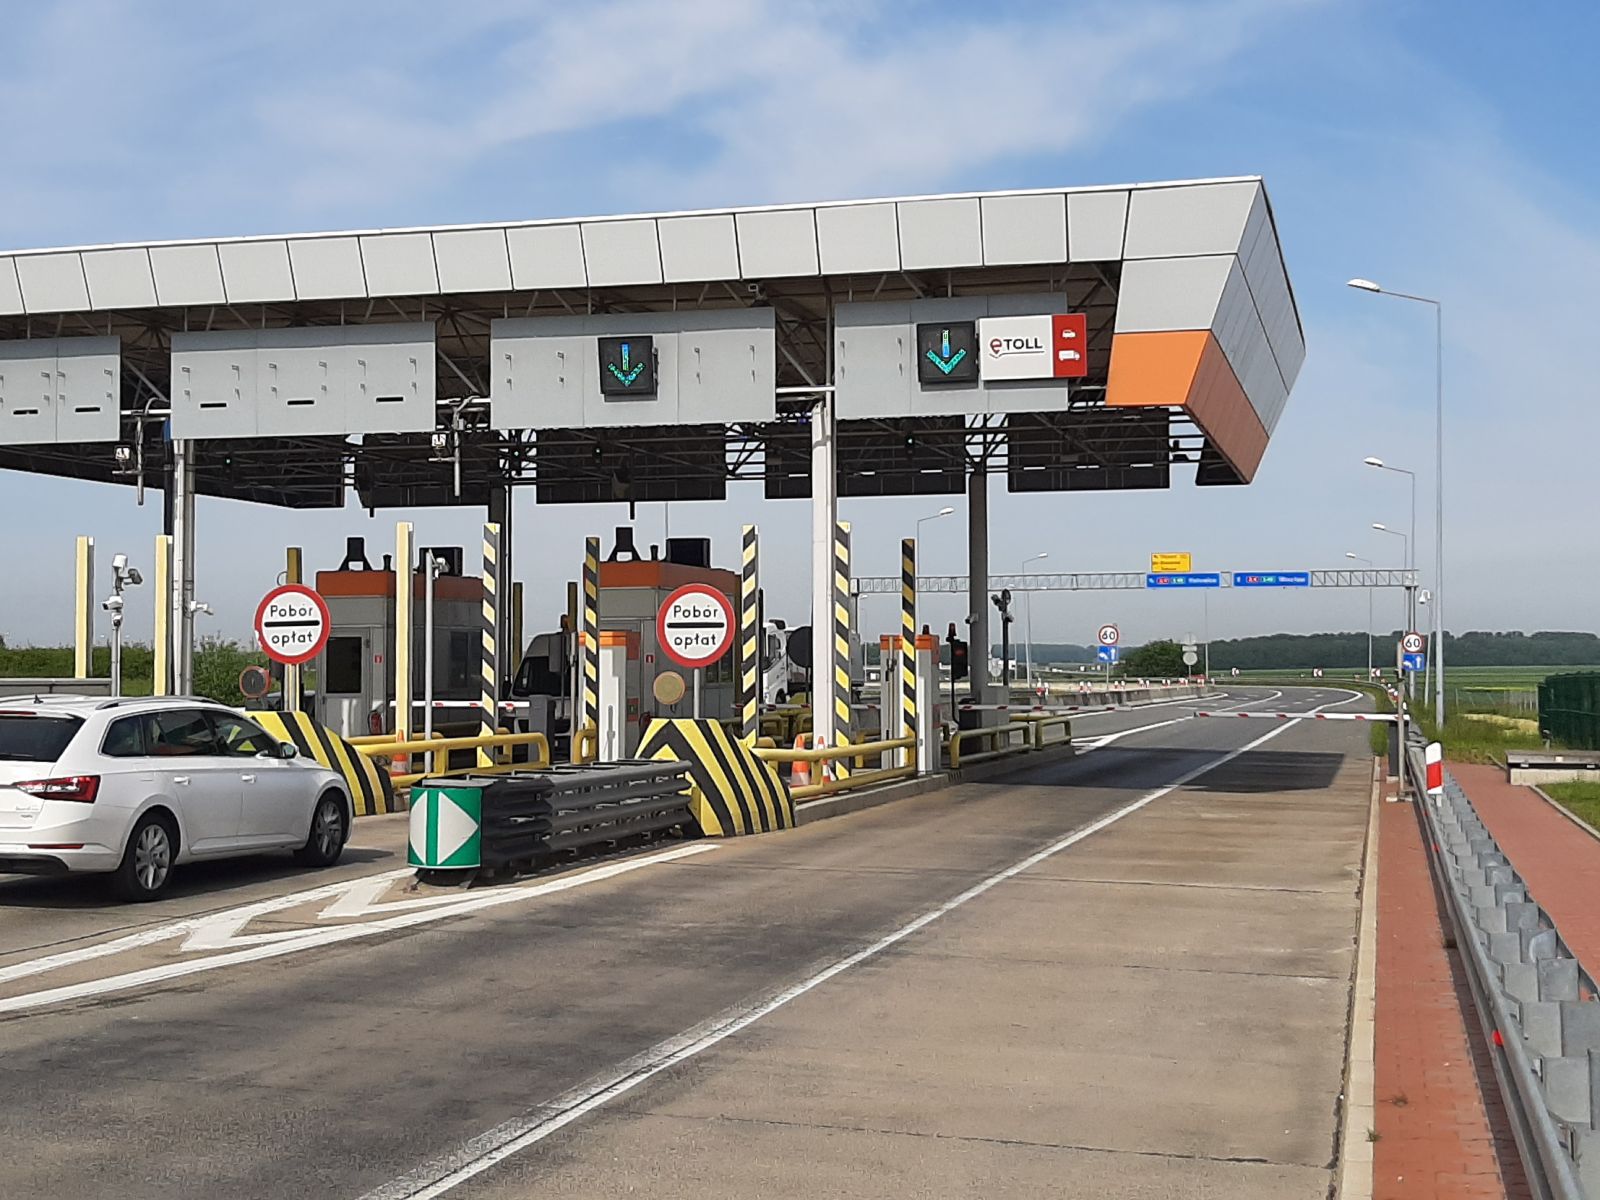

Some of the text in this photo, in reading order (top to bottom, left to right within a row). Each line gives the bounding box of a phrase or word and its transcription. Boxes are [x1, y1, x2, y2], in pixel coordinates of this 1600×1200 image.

[990, 337, 1043, 354] eTOLL
[270, 604, 313, 617] Pobór
[673, 605, 718, 618] Pobór
[271, 631, 313, 647] opłat
[674, 633, 716, 649] opłat
[1102, 631, 1115, 640] 60
[1405, 639, 1420, 648] 60
